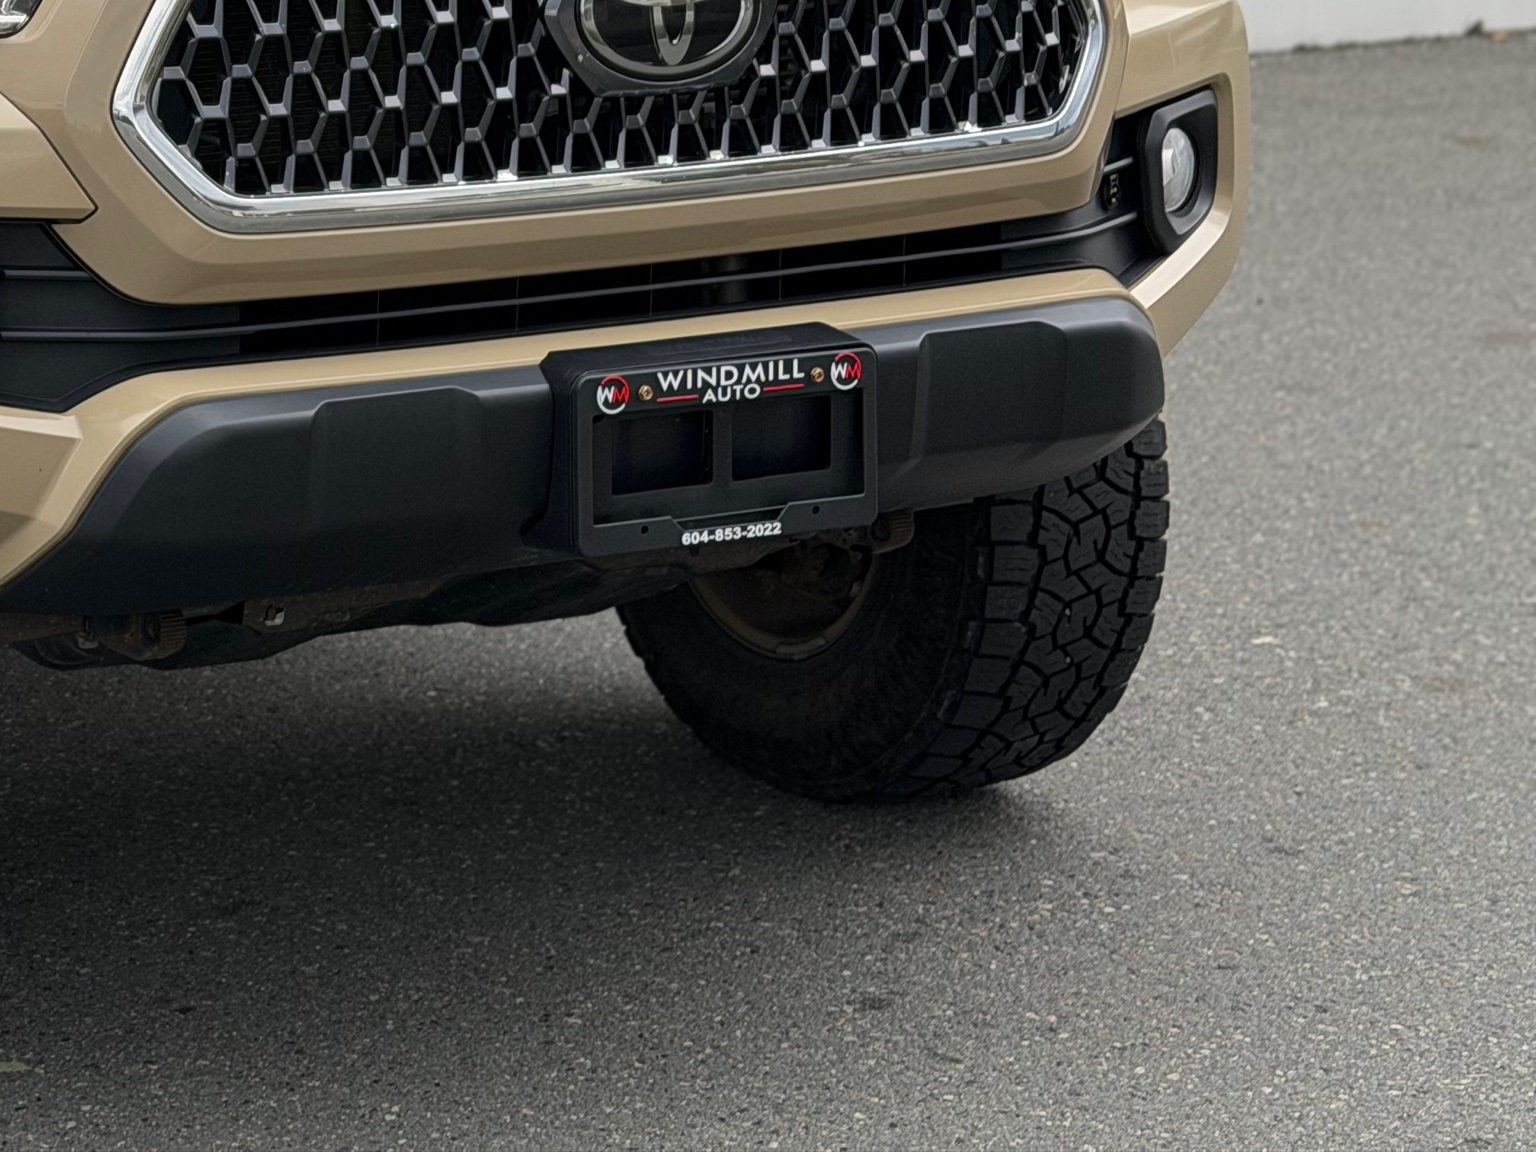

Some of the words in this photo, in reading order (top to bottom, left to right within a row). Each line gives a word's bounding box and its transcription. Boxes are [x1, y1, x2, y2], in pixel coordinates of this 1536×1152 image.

[657, 358, 806, 393] WINDMILL
[701, 383, 761, 404] AUTO
[681, 522, 782, 546] 604-853-2022
